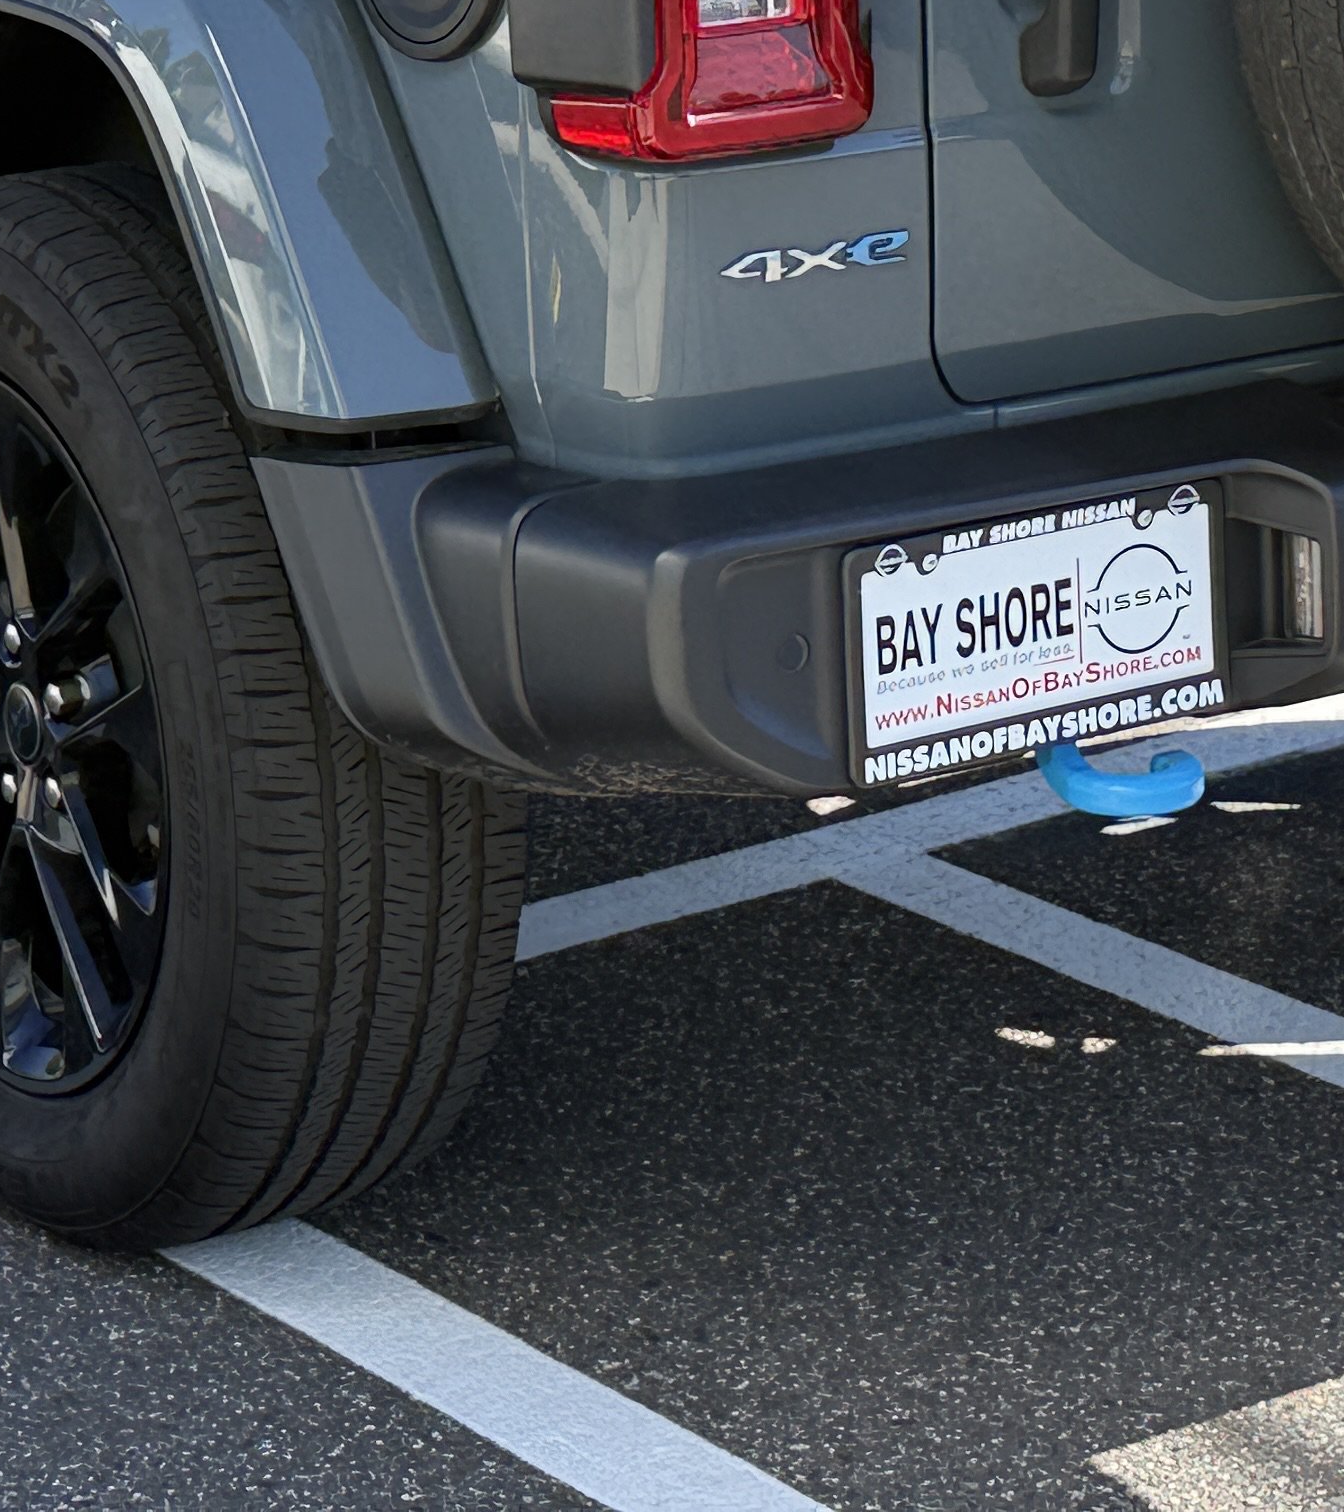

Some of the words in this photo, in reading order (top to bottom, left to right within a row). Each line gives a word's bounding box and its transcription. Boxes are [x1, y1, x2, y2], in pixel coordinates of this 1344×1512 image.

[943, 528, 985, 553] BAY
[989, 513, 1056, 545] SHORE
[1062, 498, 1136, 529] NISSAN
[876, 603, 944, 675] BAY
[956, 578, 1073, 659] SHORE
[1084, 580, 1192, 619] NISSAN
[864, 680, 1223, 785] NISSANOFBAYSHORE.COM
